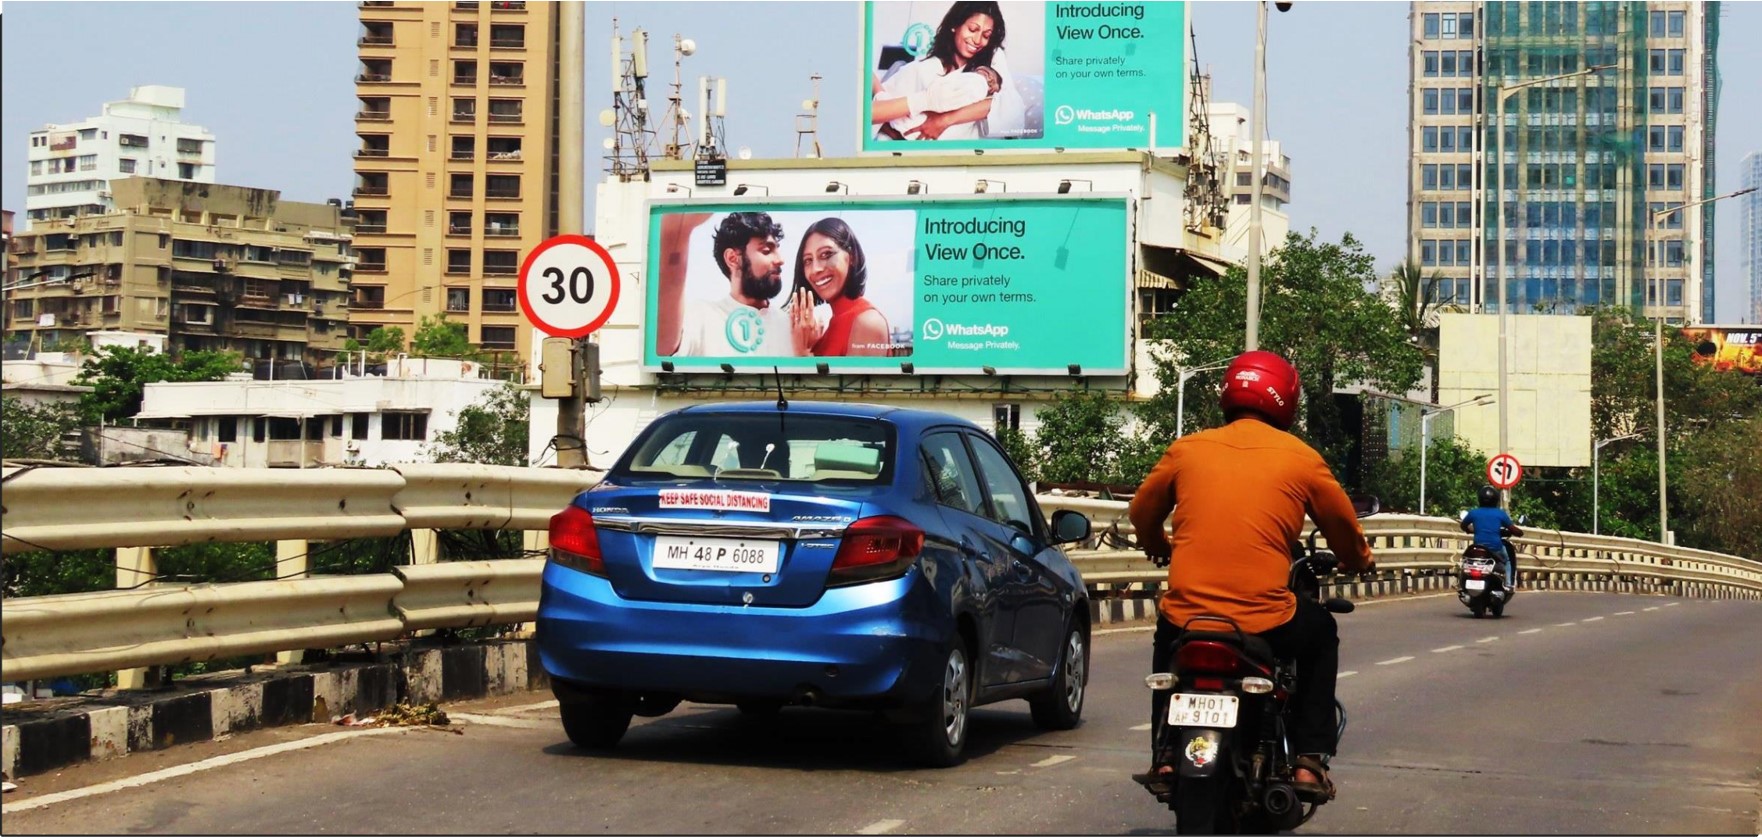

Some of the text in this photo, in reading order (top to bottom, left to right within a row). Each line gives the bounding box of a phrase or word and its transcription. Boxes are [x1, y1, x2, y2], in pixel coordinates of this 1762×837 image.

[1056, 3, 1144, 20] Introducing
[1056, 24, 1144, 40] View Once.
[1055, 56, 1126, 66] Share privately
[1070, 71, 1091, 80] your
[1094, 70, 1114, 78] own
[1116, 69, 1146, 77] terms.
[1076, 109, 1134, 121] WhatsApp
[1078, 124, 1145, 133] Message Privately.
[925, 217, 1026, 237] Introducing
[925, 242, 1025, 260] View Once.
[541, 266, 594, 305] 30
[923, 274, 1011, 288] Share privately
[923, 290, 1037, 306] on your own terms.
[945, 324, 1009, 337] WhatsApp
[1726, 332, 1748, 344] NOV.
[947, 341, 1020, 351] Message Privately.
[1266, 386, 1285, 407] STYLO
[660, 492, 768, 509] KEEP SAFE SOCIAL DISTANCING
[667, 546, 765, 563] MH 48 P 6088
[1188, 697, 1224, 711] MH01
[1192, 710, 1228, 725] 9101
